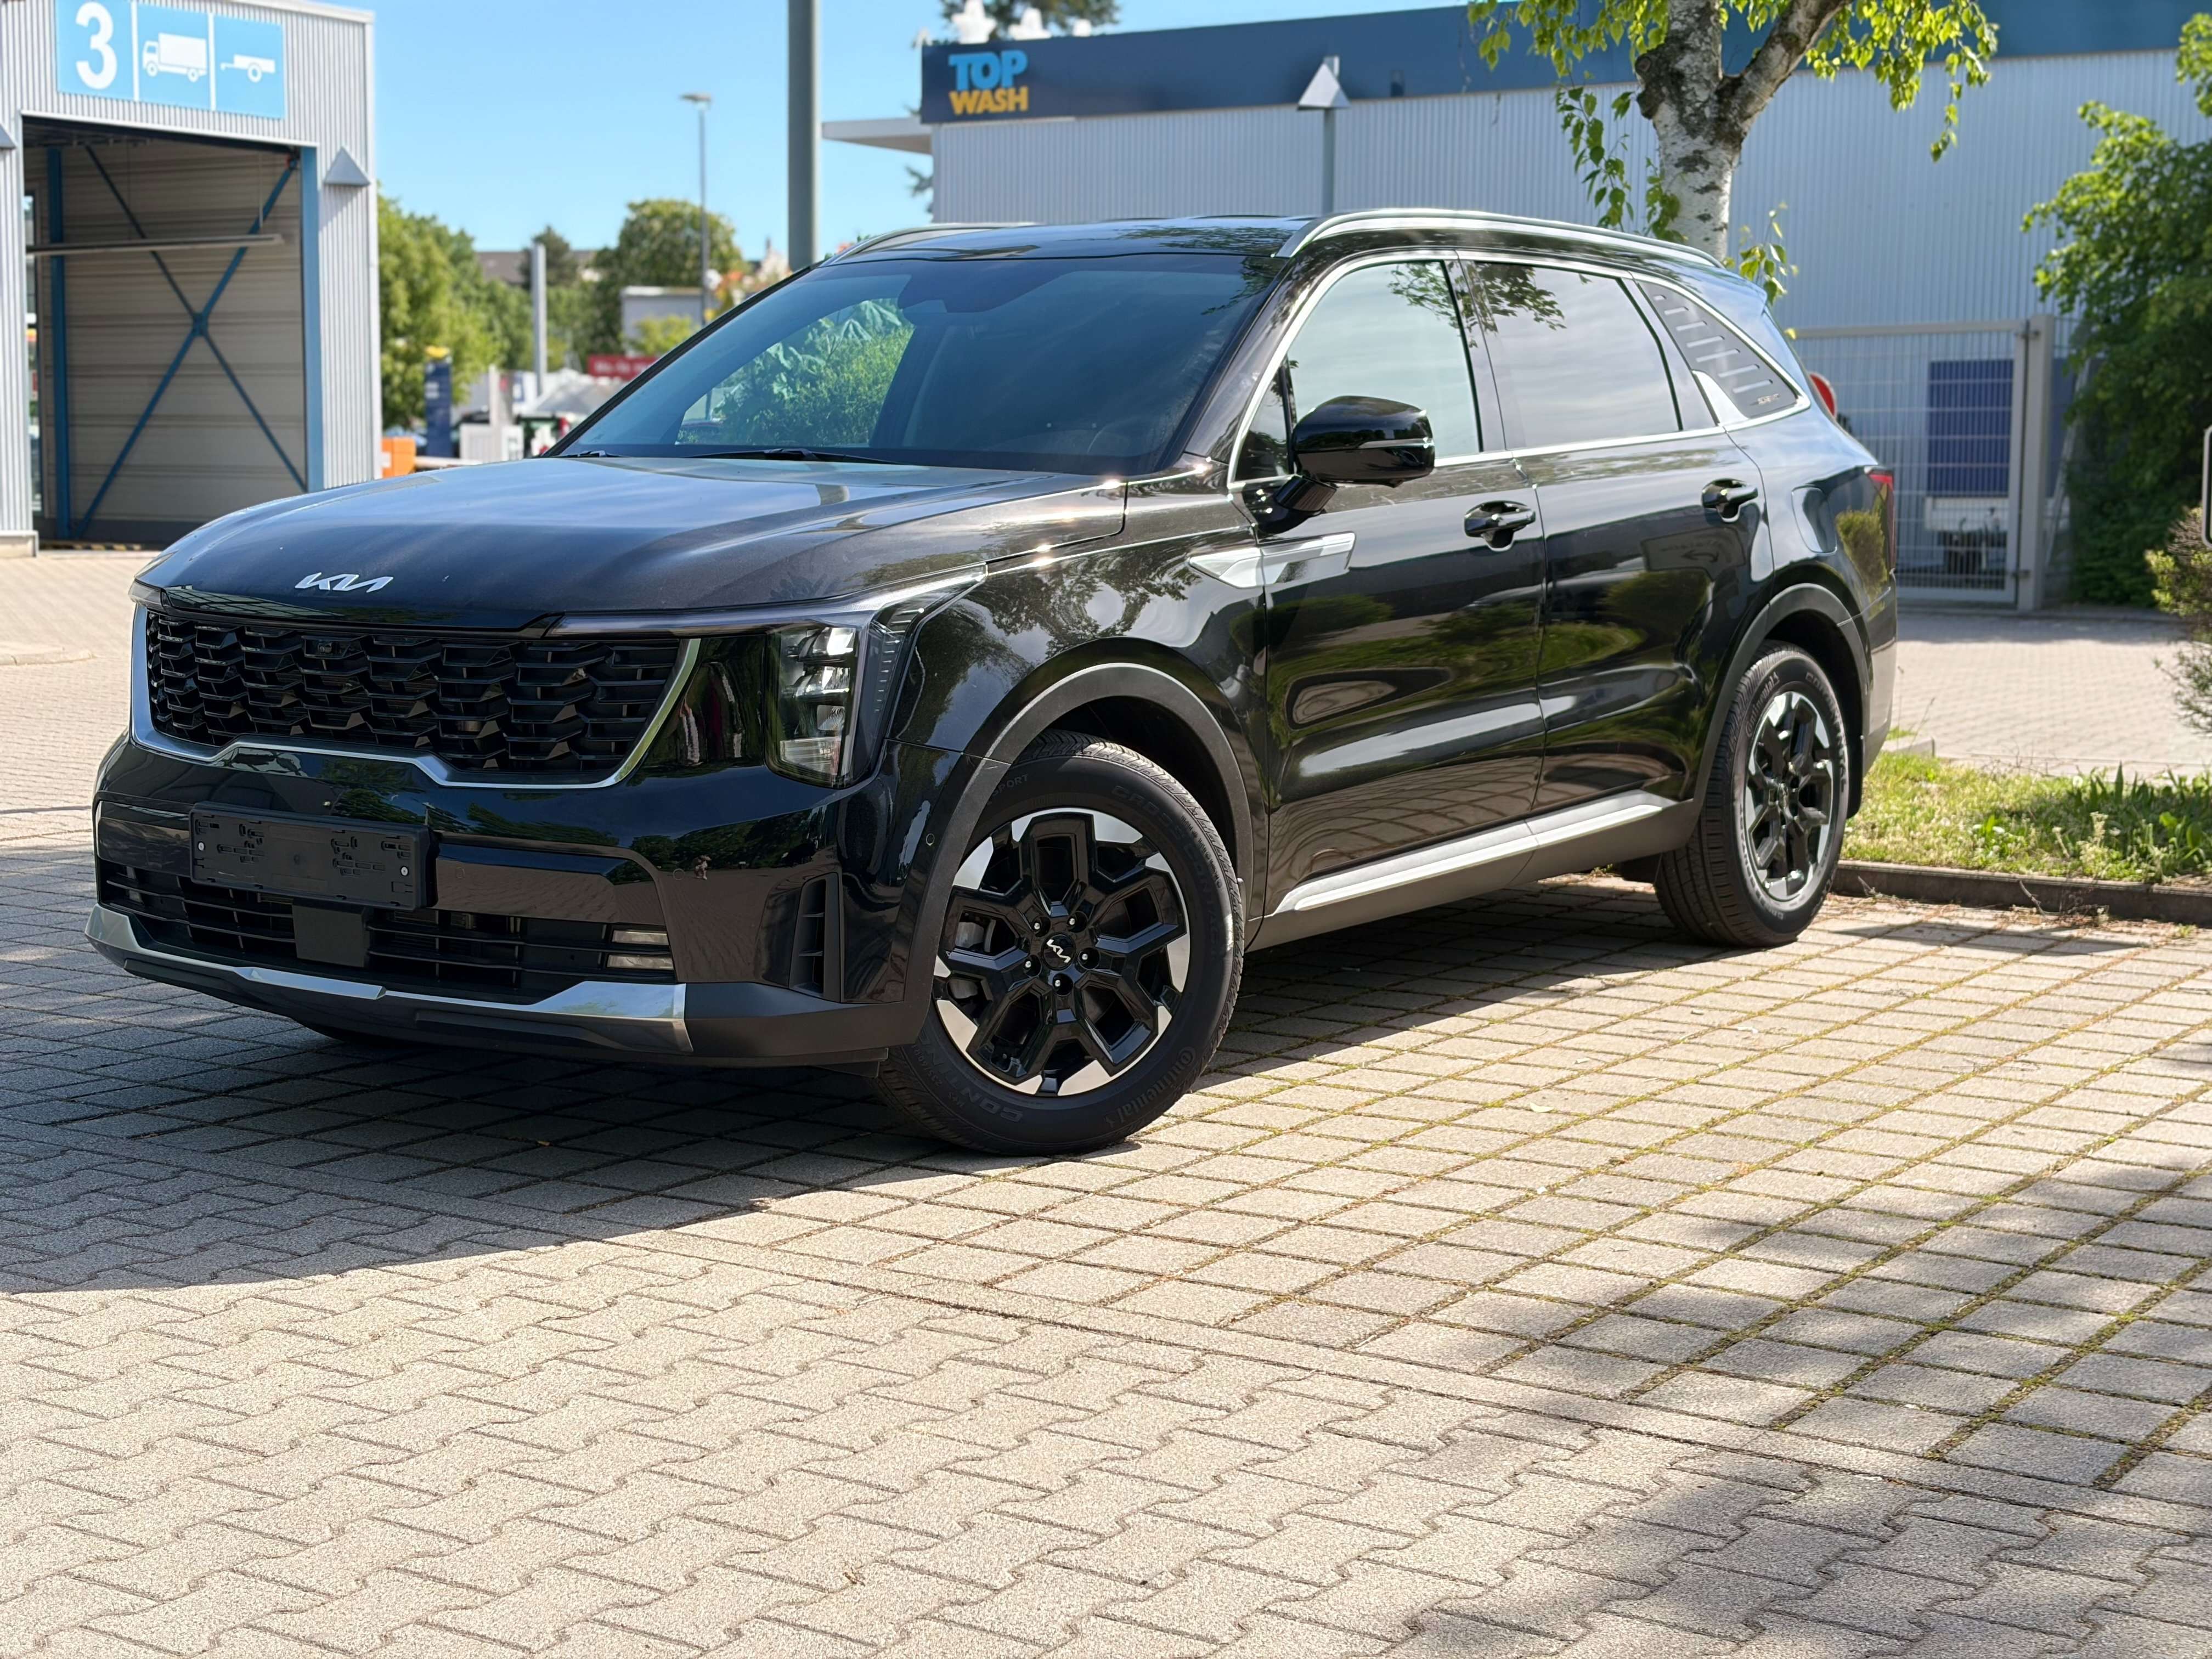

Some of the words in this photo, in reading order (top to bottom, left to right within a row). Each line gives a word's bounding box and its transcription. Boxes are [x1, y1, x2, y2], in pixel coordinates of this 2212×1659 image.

[75, 2, 117, 89] 3
[949, 50, 1028, 91] TOP
[949, 86, 1029, 115] WASH
[295, 572, 394, 592] KIA
[1114, 1042, 1198, 1125] Continental
